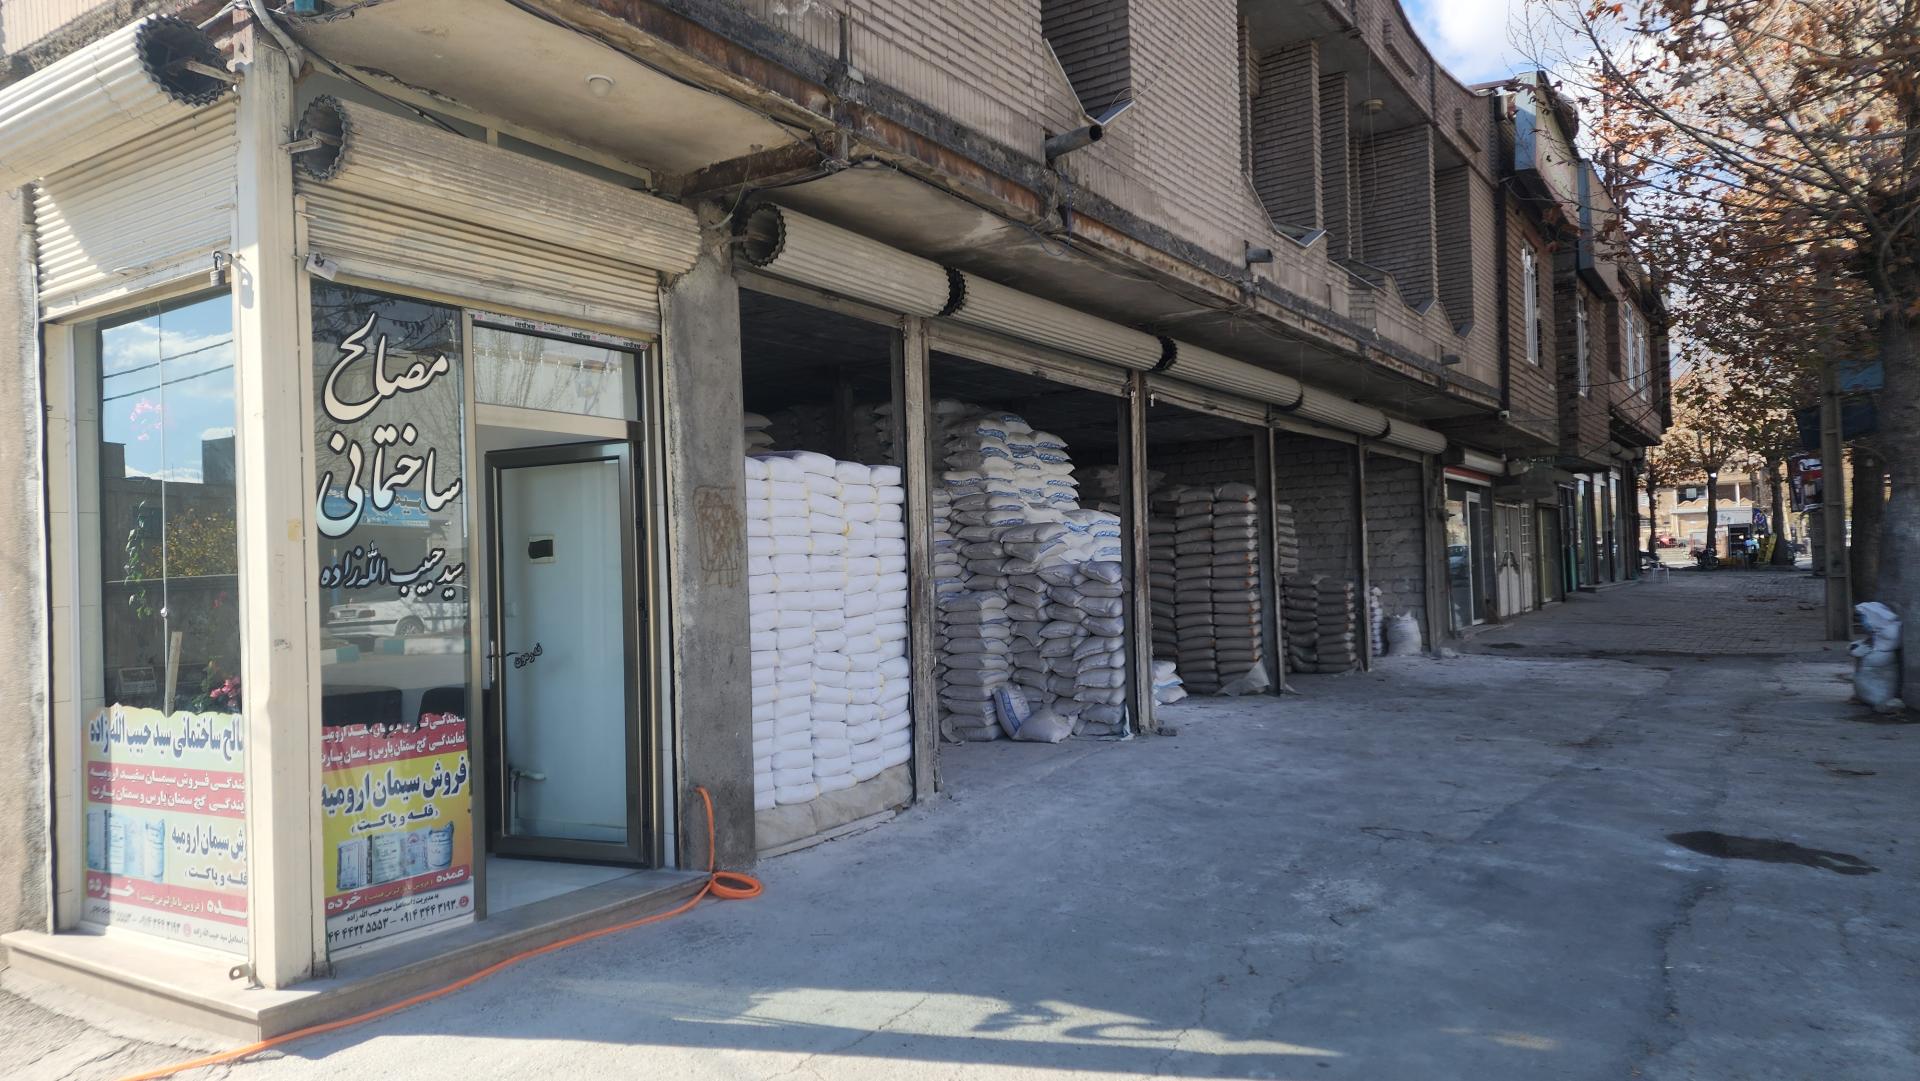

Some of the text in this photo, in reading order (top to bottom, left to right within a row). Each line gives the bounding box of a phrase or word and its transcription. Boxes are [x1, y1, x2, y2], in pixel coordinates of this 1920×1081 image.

[323, 311, 449, 424] مصالح
[316, 423, 463, 538] ساختمانی
[320, 547, 361, 588] زاده
[389, 546, 445, 597] حبیب
[437, 561, 465, 600] سید
[90, 714, 109, 753] زاده
[126, 724, 152, 754] حبیب
[153, 724, 172, 755] سید
[173, 716, 221, 758] ساختمانی
[223, 715, 244, 761] الح
[321, 727, 346, 743] ارومی
[429, 730, 465, 751] نمایندگی
[373, 741, 393, 760] پارس
[145, 770, 176, 786] سیمان
[176, 772, 209, 789] فروش
[210, 775, 246, 792] یندگی
[373, 769, 420, 807] سیمان
[422, 756, 468, 798] فروش
[208, 797, 246, 813] یندگی
[400, 815, 406, 826] و
[171, 823, 199, 855] ارومیه
[201, 825, 229, 857] سیمان
[88, 877, 135, 898] خرده
[220, 874, 225, 886] و
[436, 868, 464, 883] عمده
[328, 891, 362, 911] خرده
